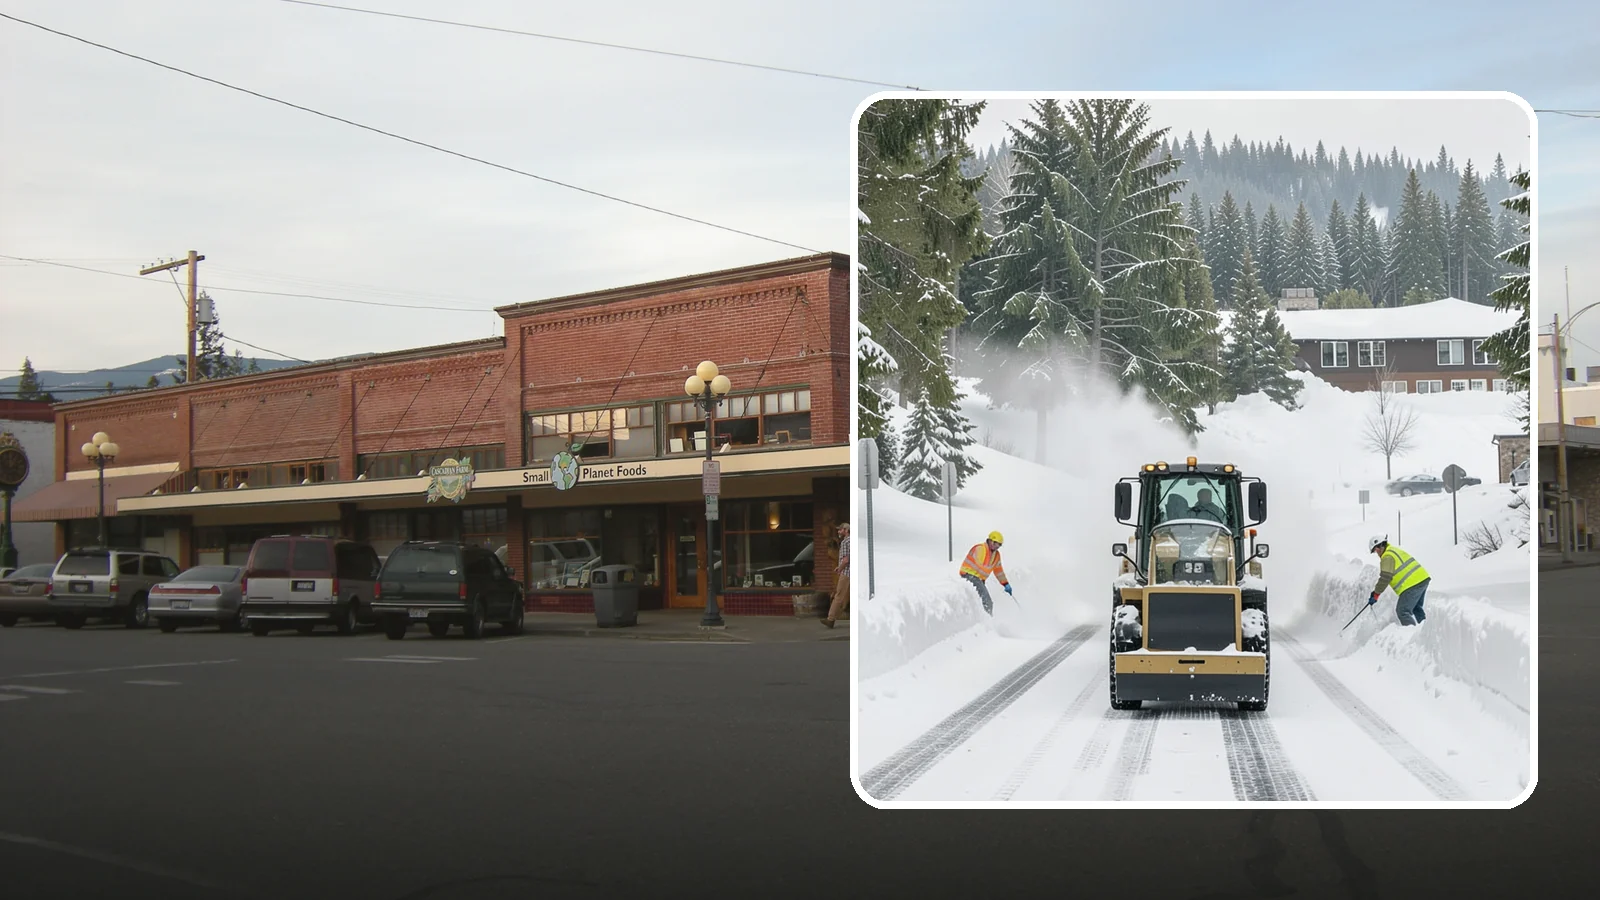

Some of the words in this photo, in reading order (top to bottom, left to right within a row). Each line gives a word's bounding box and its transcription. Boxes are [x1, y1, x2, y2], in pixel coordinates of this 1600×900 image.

[523, 471, 549, 483] Small
[582, 468, 614, 479] Planet
[616, 464, 647, 477] Foods
